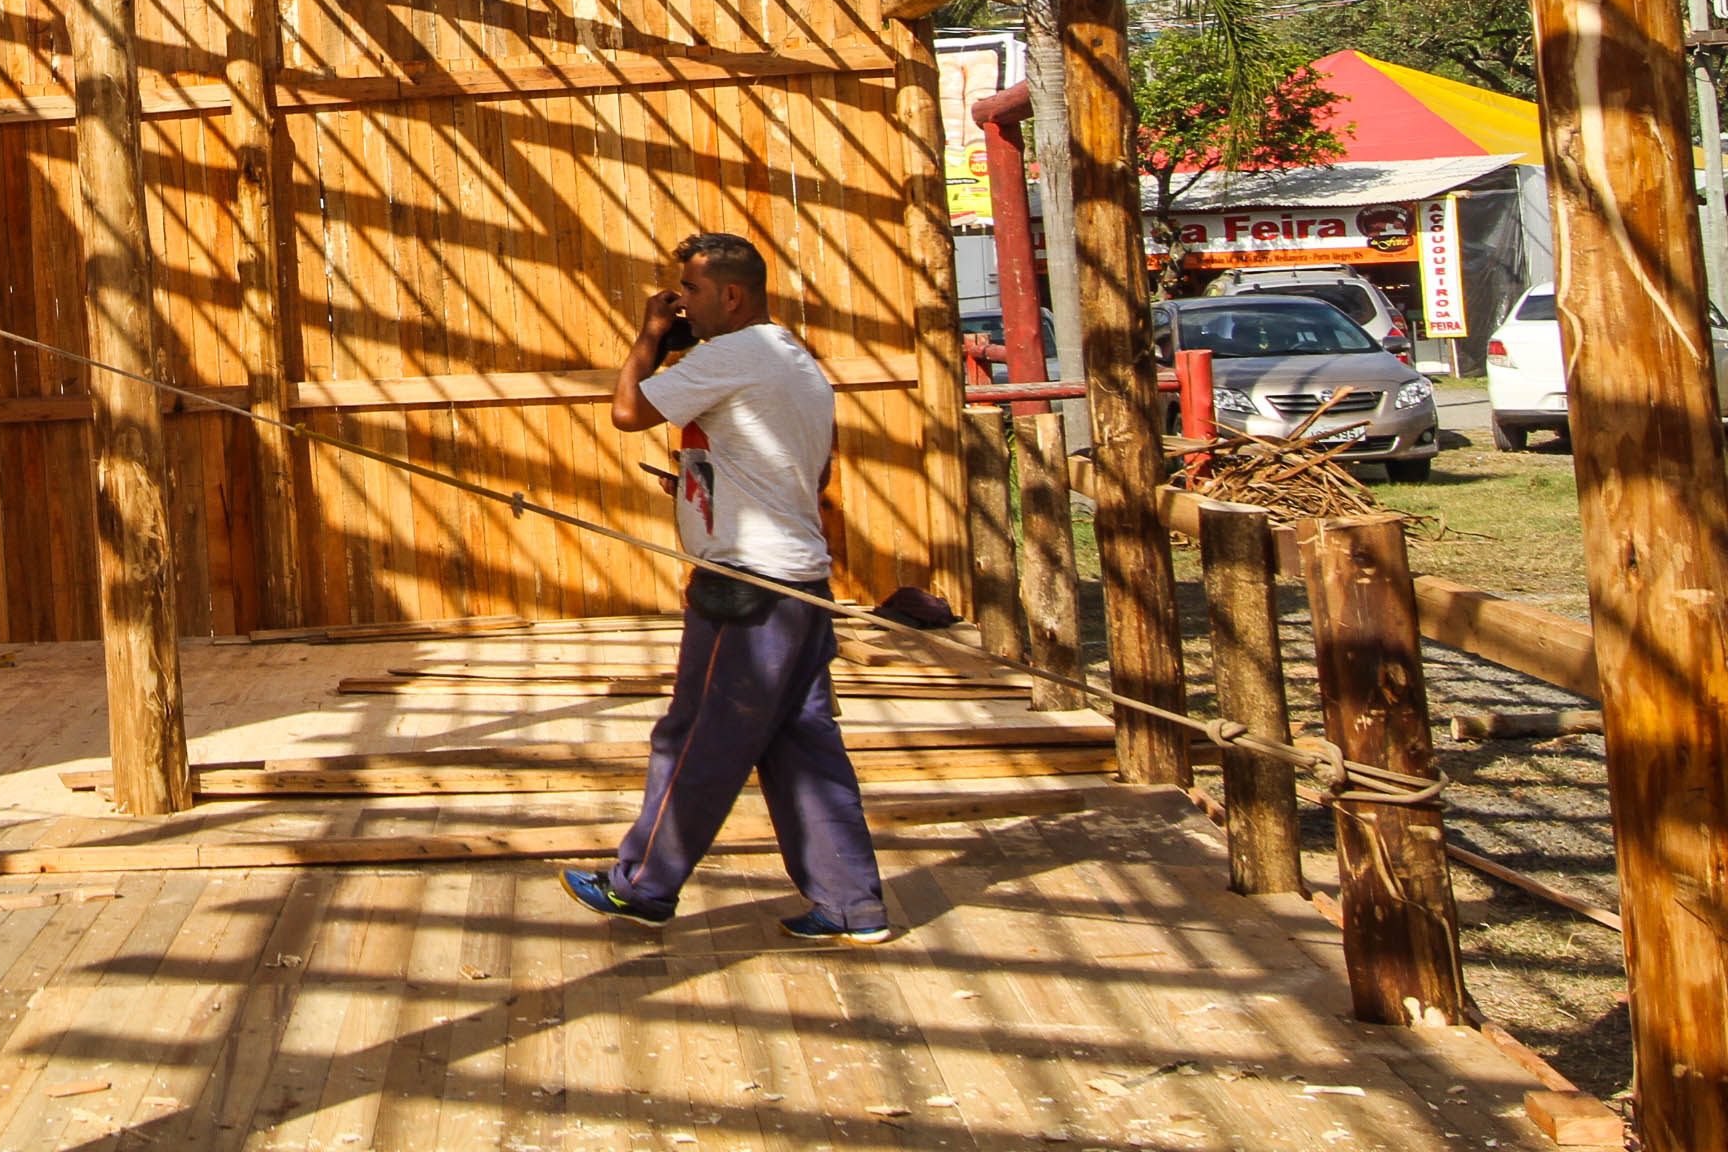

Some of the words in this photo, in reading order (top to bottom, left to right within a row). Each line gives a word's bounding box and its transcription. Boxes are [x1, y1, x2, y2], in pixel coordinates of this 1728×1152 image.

[1224, 214, 1347, 243] Feira
[1428, 203, 1450, 308] AÇOUGUEIRO
[1430, 321, 1463, 331] FEIRA
